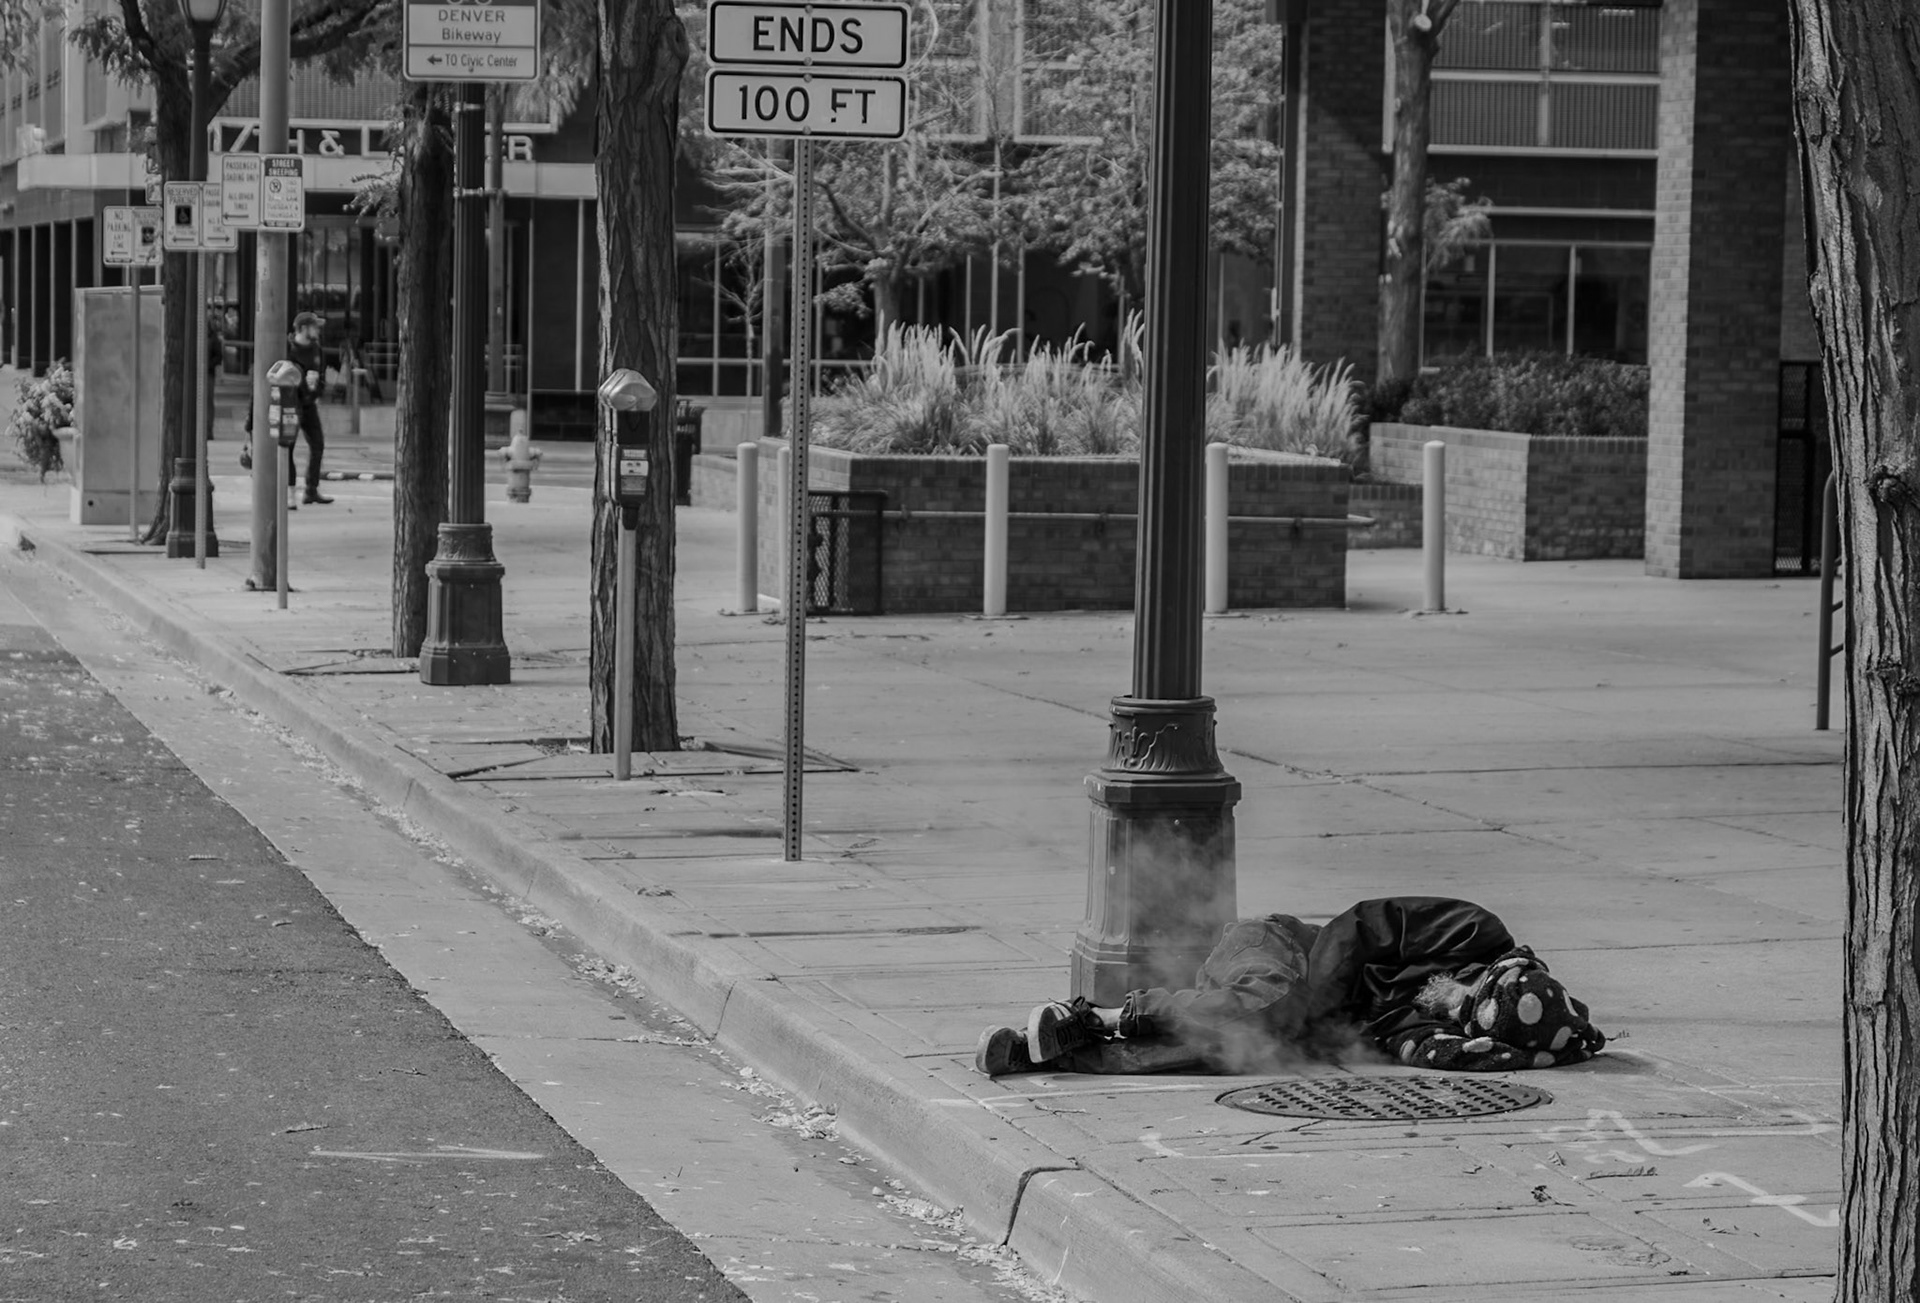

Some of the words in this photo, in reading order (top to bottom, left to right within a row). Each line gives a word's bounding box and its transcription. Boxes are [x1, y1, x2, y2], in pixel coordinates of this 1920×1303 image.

[438, 9, 506, 22] DENVER
[442, 27, 501, 43] Bikeway
[752, 16, 864, 54] ENDS
[445, 53, 457, 66] TO
[461, 54, 484, 67] Civic
[487, 54, 518, 67] Center
[738, 84, 809, 122] 100
[830, 88, 876, 124] FT
[319, 130, 345, 158] &
[225, 161, 257, 170] PASSENGER
[268, 168, 298, 176] SWEEPING
